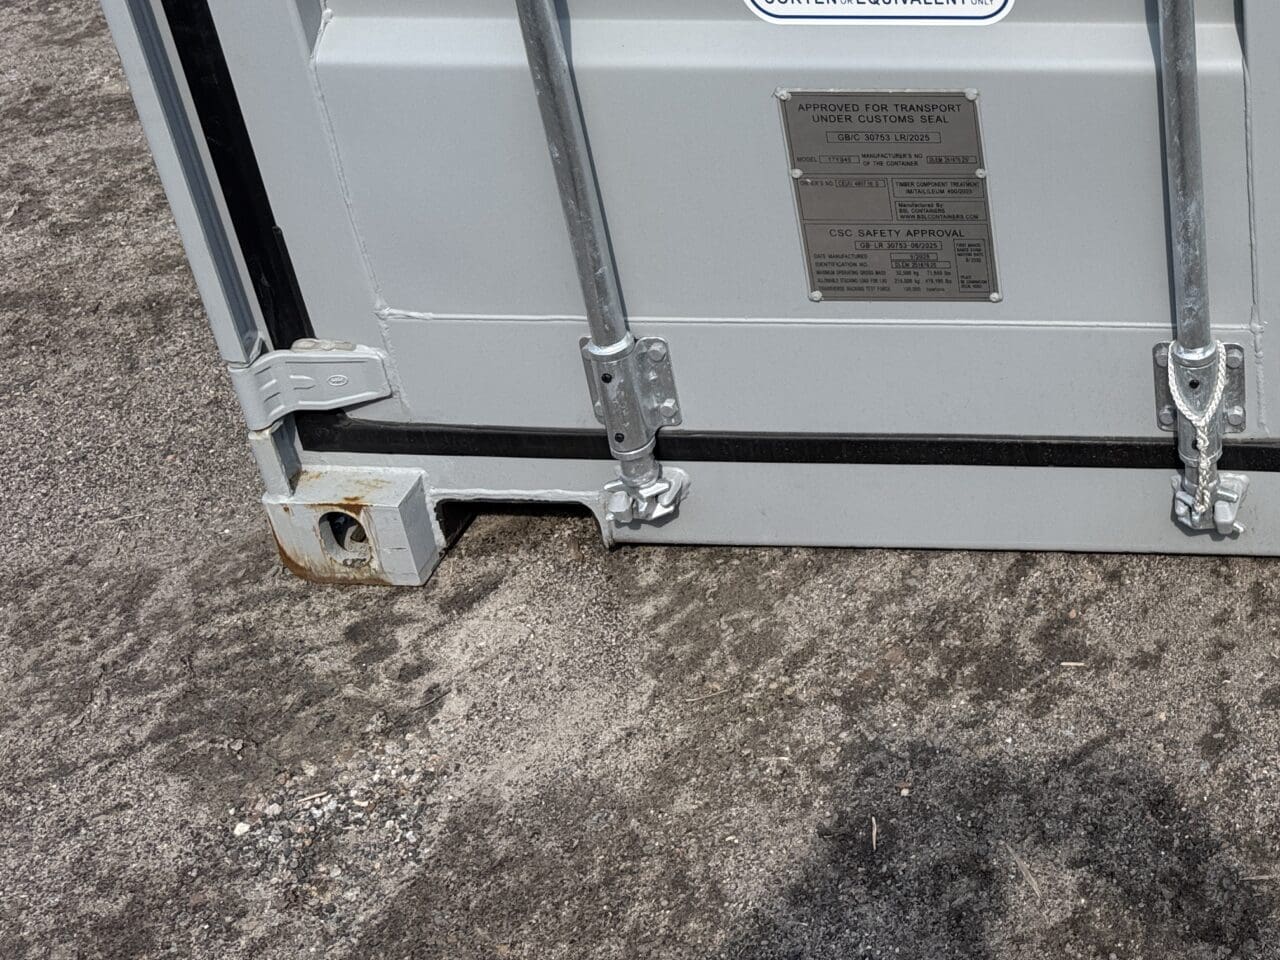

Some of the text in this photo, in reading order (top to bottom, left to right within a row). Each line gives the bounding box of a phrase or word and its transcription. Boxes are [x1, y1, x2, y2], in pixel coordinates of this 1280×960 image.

[798, 103, 961, 112] APPROVED FOR TRANSPORT
[812, 115, 949, 123] UNDER CUSTOMS SEAL
[829, 229, 965, 238] CSC SAFETY APPROVAL
